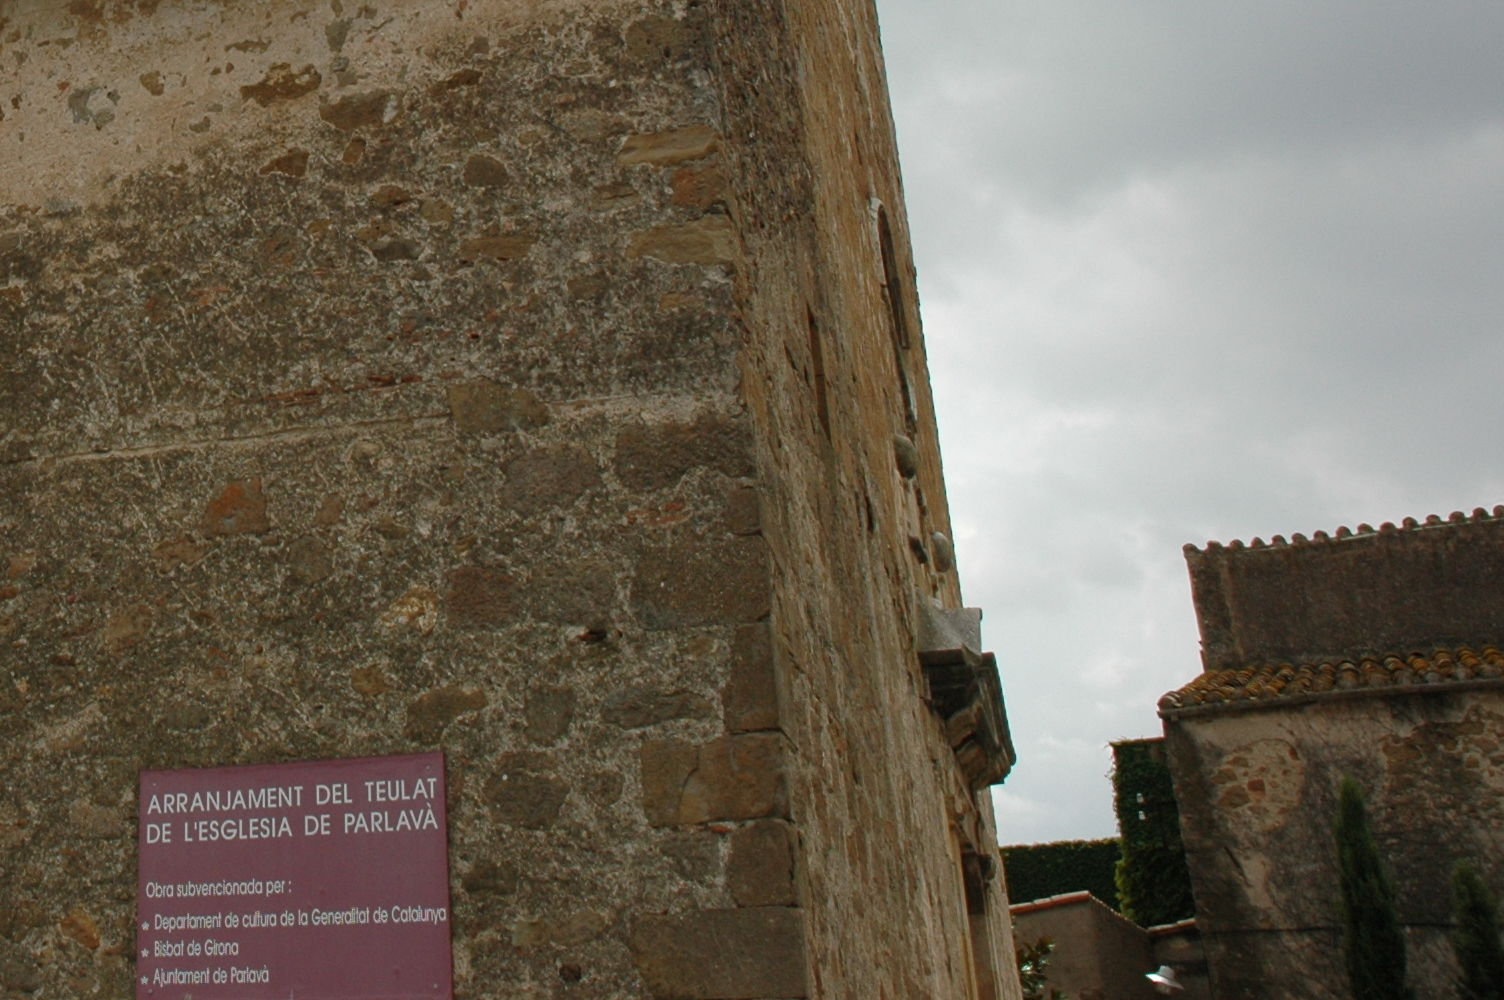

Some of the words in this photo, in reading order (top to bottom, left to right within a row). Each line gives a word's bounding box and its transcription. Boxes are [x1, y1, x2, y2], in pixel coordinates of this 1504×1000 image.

[147, 786, 303, 815] ARRANJAMENT
[316, 783, 352, 805] DEL
[365, 778, 437, 802] TEULAT
[146, 823, 171, 844] DE
[185, 817, 292, 842] L'ESGLESIA
[305, 815, 330, 836] DE
[344, 803, 438, 833] PARLAVÀ
[146, 881, 174, 898] Obra
[177, 878, 263, 896] subvencionada
[154, 913, 221, 932] Departament
[225, 911, 238, 927] de
[242, 910, 277, 927] cultura
[281, 909, 295, 926] de
[299, 909, 308, 925] la
[311, 907, 369, 925] Generalitat
[374, 906, 388, 923] de
[391, 904, 446, 925] Catalunya
[154, 940, 183, 957] Bisbat
[187, 940, 200, 956] de
[205, 939, 239, 955] Girona
[153, 967, 210, 987] Ajuntament
[213, 966, 227, 983] de
[231, 964, 269, 983] Parlavà
